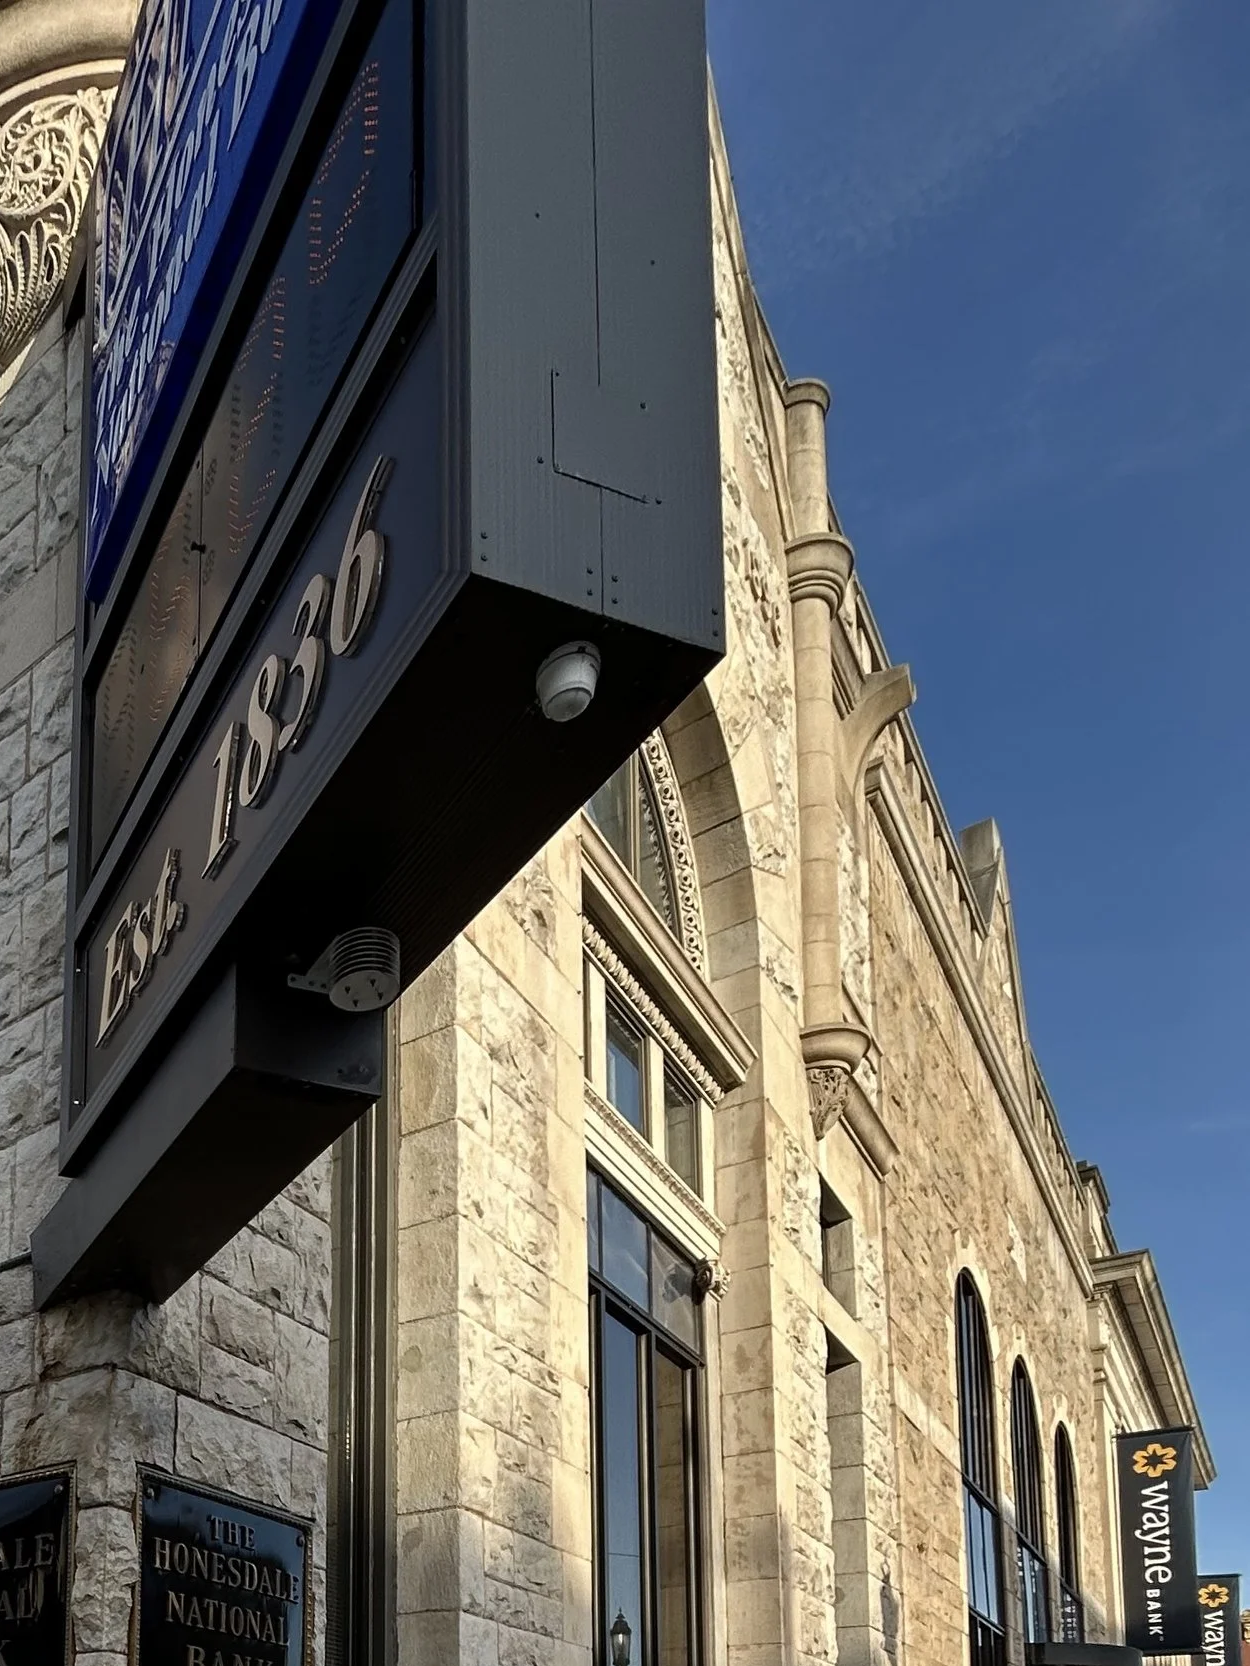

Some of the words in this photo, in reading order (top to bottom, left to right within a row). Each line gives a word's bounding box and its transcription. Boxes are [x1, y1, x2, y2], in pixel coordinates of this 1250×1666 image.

[91, 109, 220, 526] National
[94, 286, 141, 455] The
[96, 847, 185, 1048] Est.
[201, 454, 389, 879] 1836
[153, 1537, 299, 1604] HONESDALE
[209, 1515, 256, 1550] THE
[1134, 1481, 1173, 1583] wayne
[165, 1590, 290, 1647] NATIONAL
[1146, 1589, 1163, 1635] BANK
